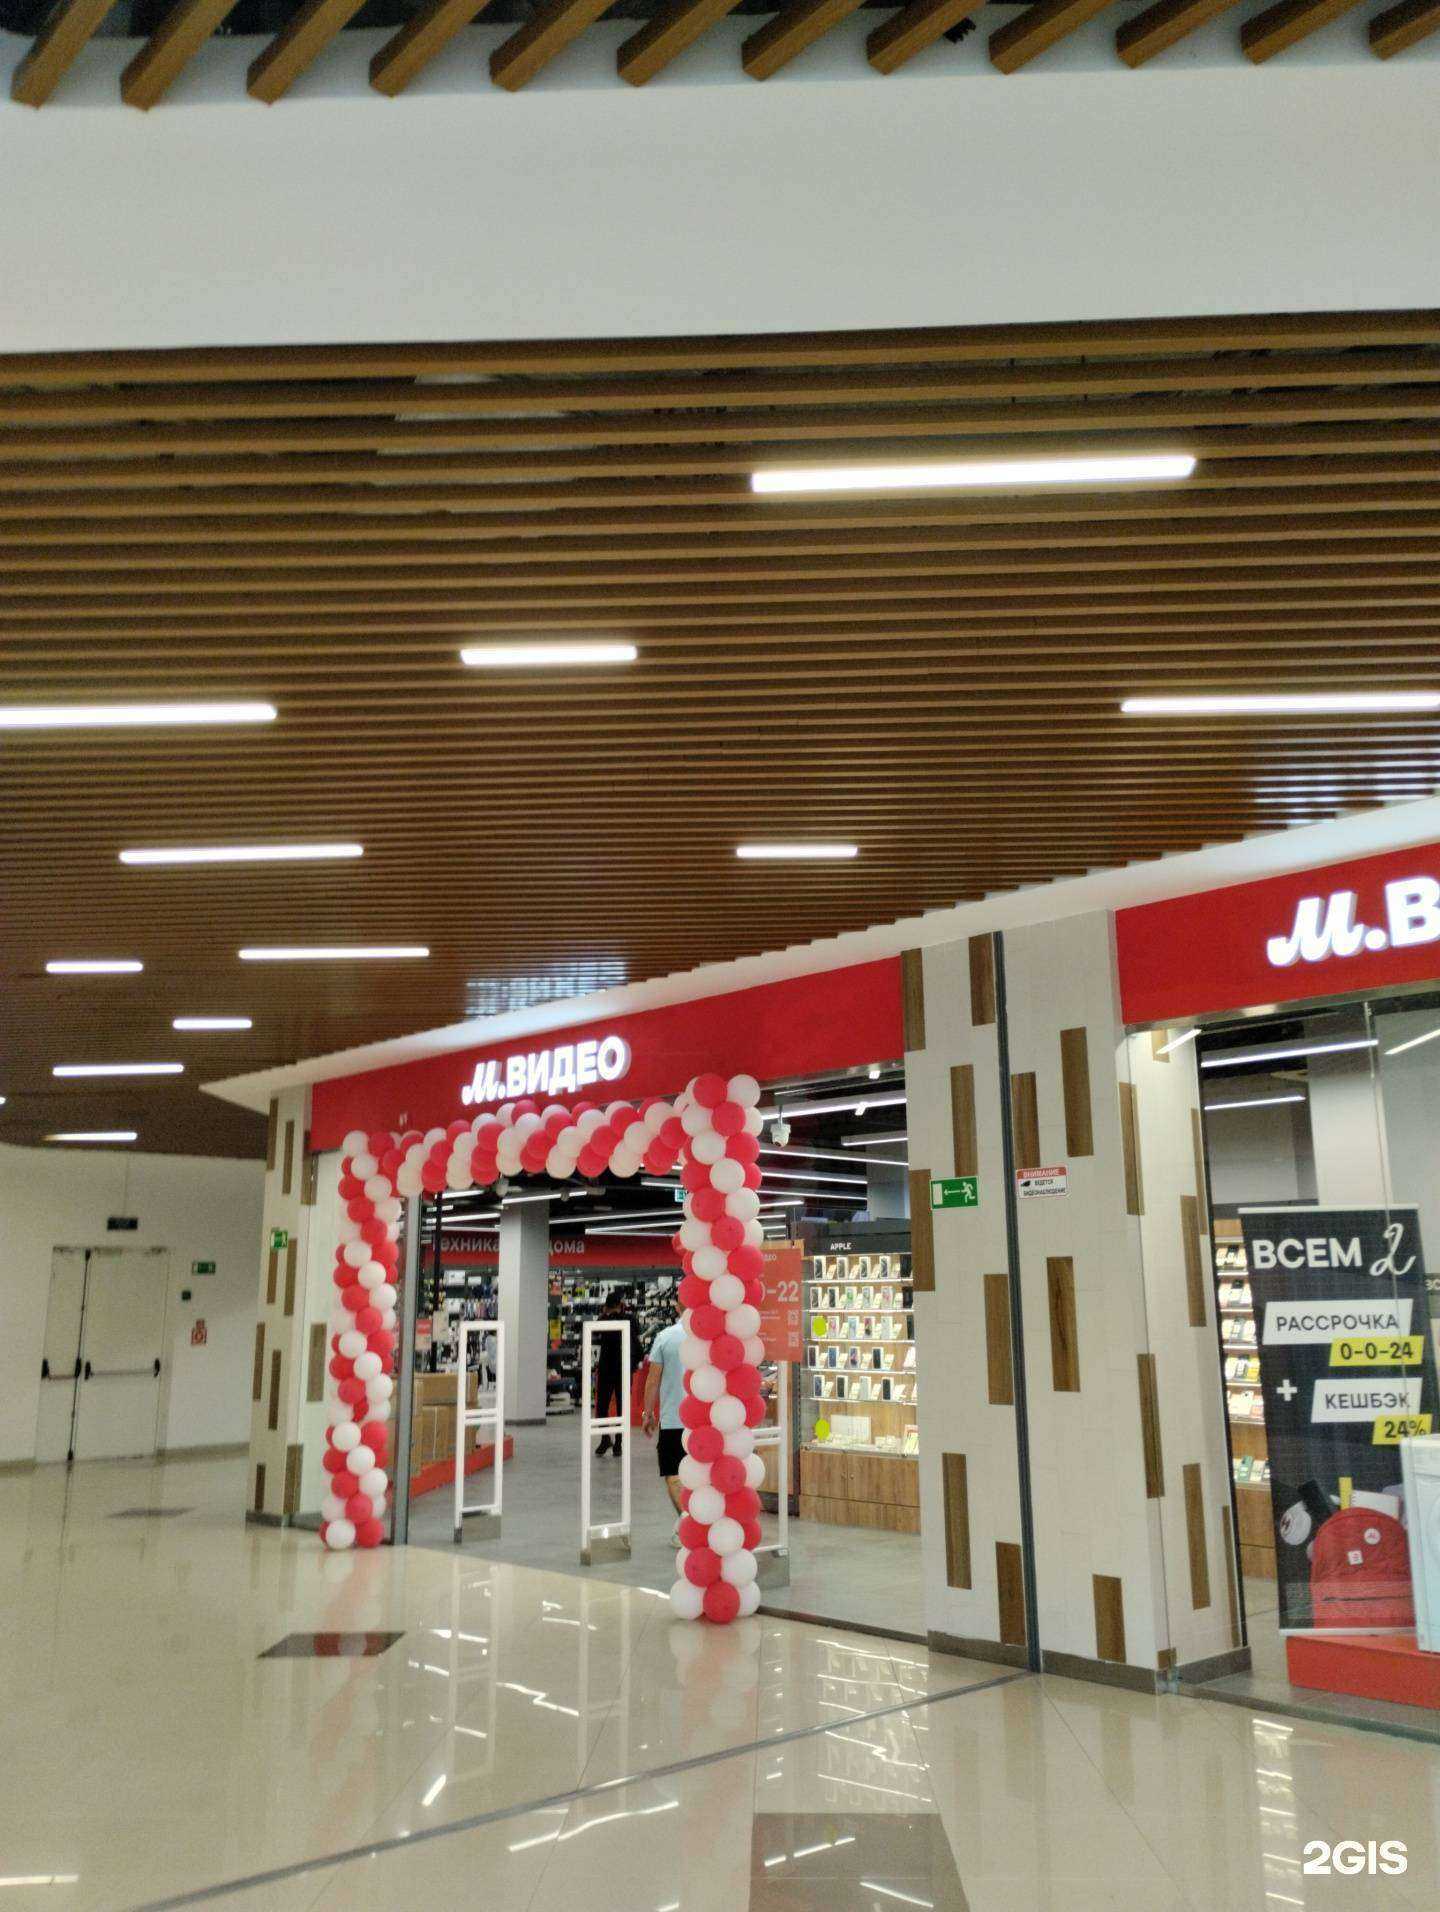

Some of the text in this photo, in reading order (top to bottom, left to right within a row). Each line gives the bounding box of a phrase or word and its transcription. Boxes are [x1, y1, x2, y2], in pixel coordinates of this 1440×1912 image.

[460, 1035, 631, 1106] М.ВИДЕО
[830, 1242, 852, 1251] APPLE
[1252, 1237, 1363, 1270] ВСЕМ
[1276, 1314, 1400, 1332] РАССРОЧКА
[1339, 1341, 1414, 1361] 0-0-24
[1324, 1392, 1412, 1410] КЕШБЭК
[1383, 1419, 1427, 1440] 24%
